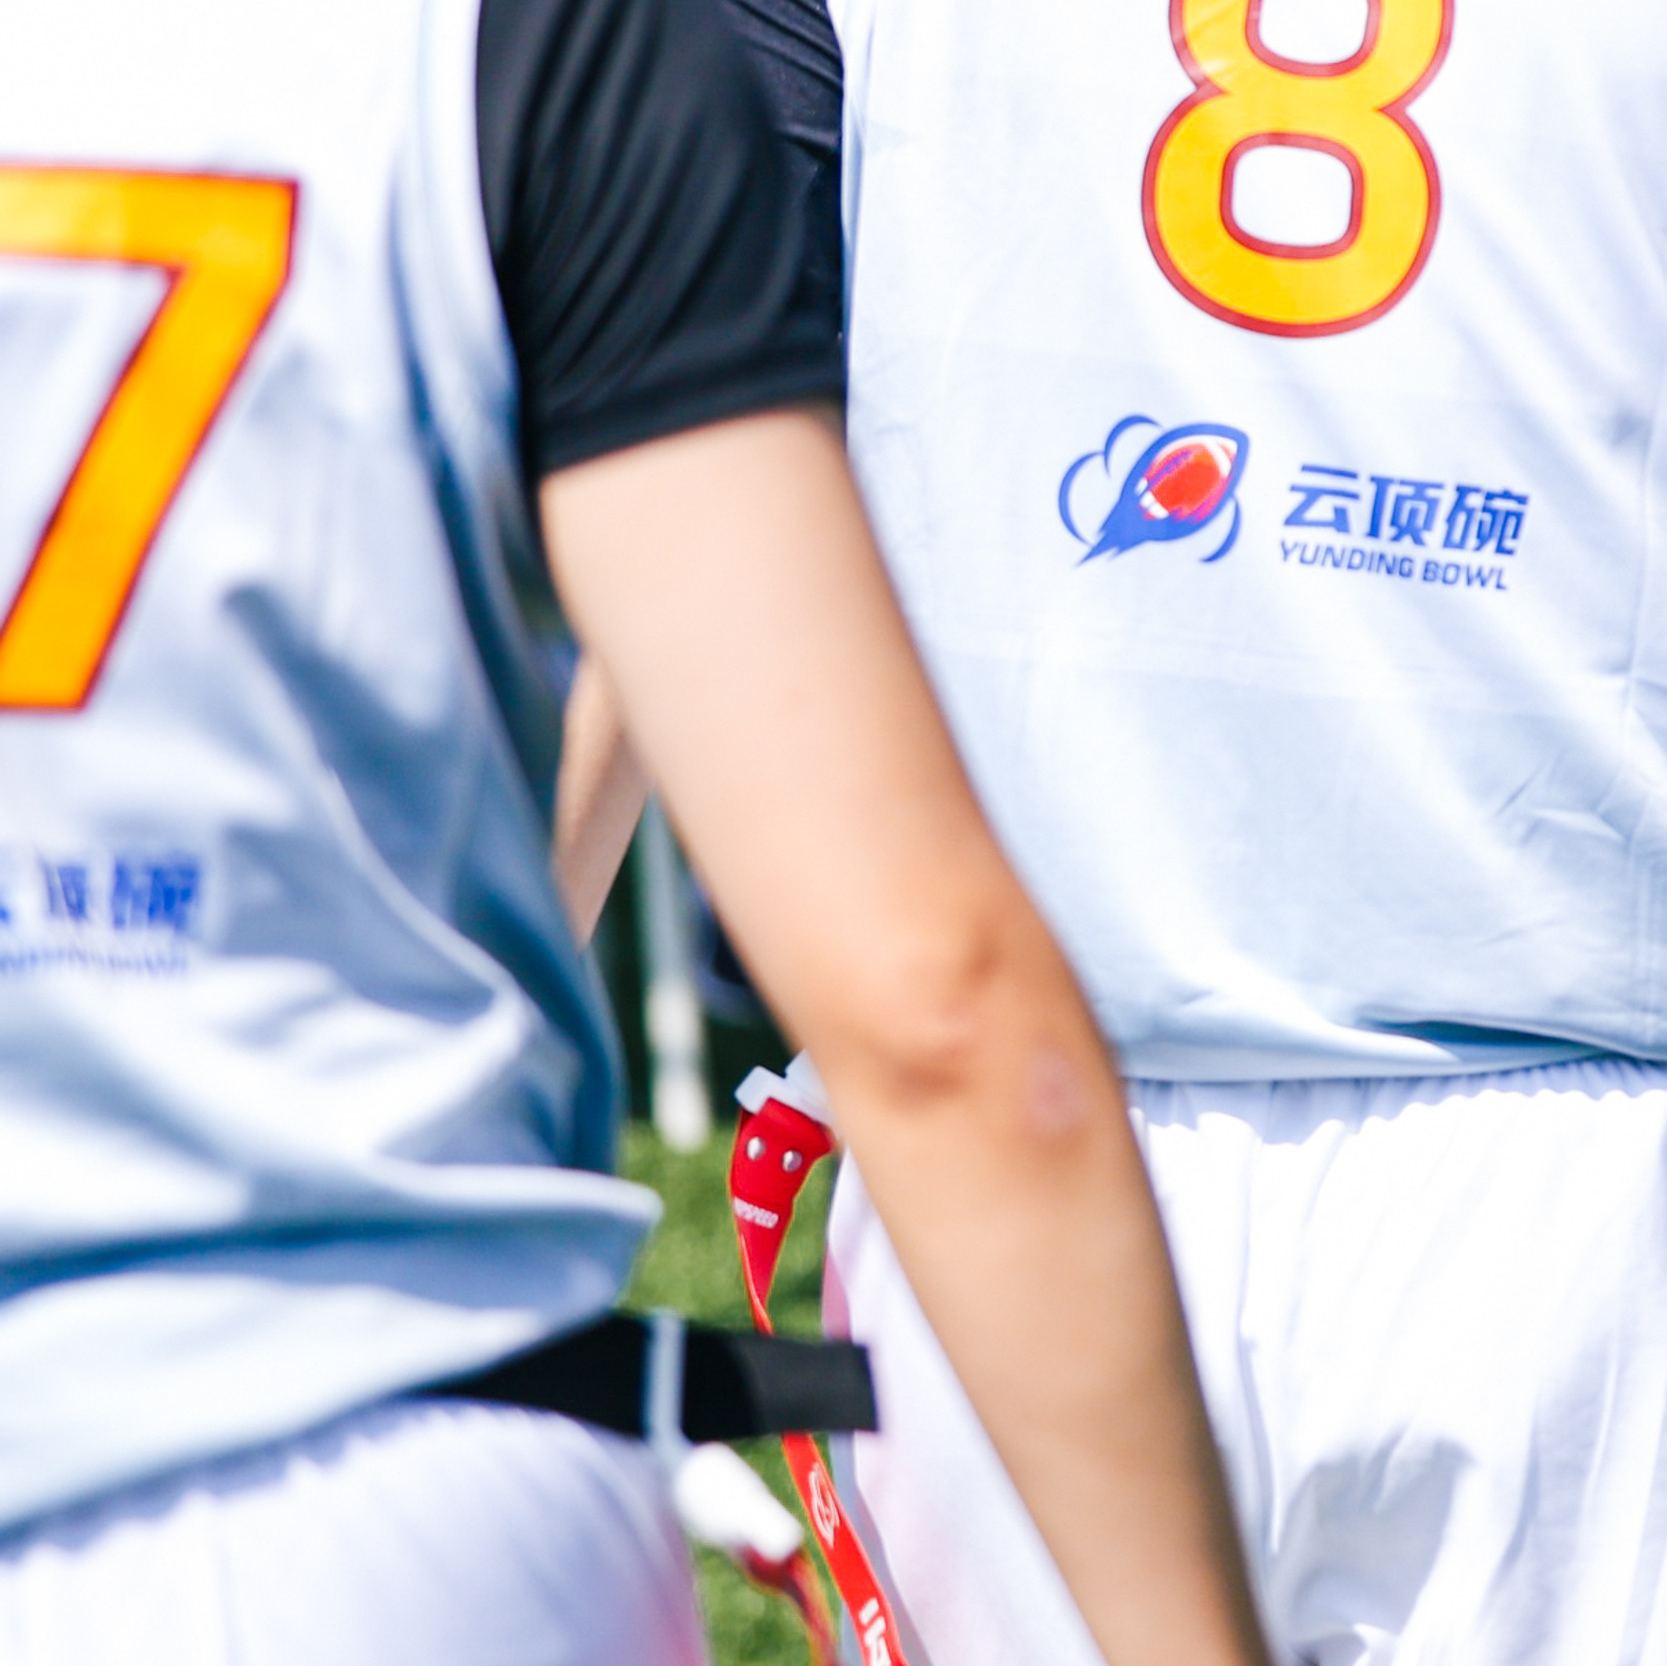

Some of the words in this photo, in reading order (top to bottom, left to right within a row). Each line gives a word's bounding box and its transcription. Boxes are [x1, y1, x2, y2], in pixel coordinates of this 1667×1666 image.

[0, 160, 301, 718] 7
[1283, 464, 1529, 556] 云顶碗
[1280, 539, 1415, 579] YUNDING
[1422, 559, 1508, 591] BOWL
